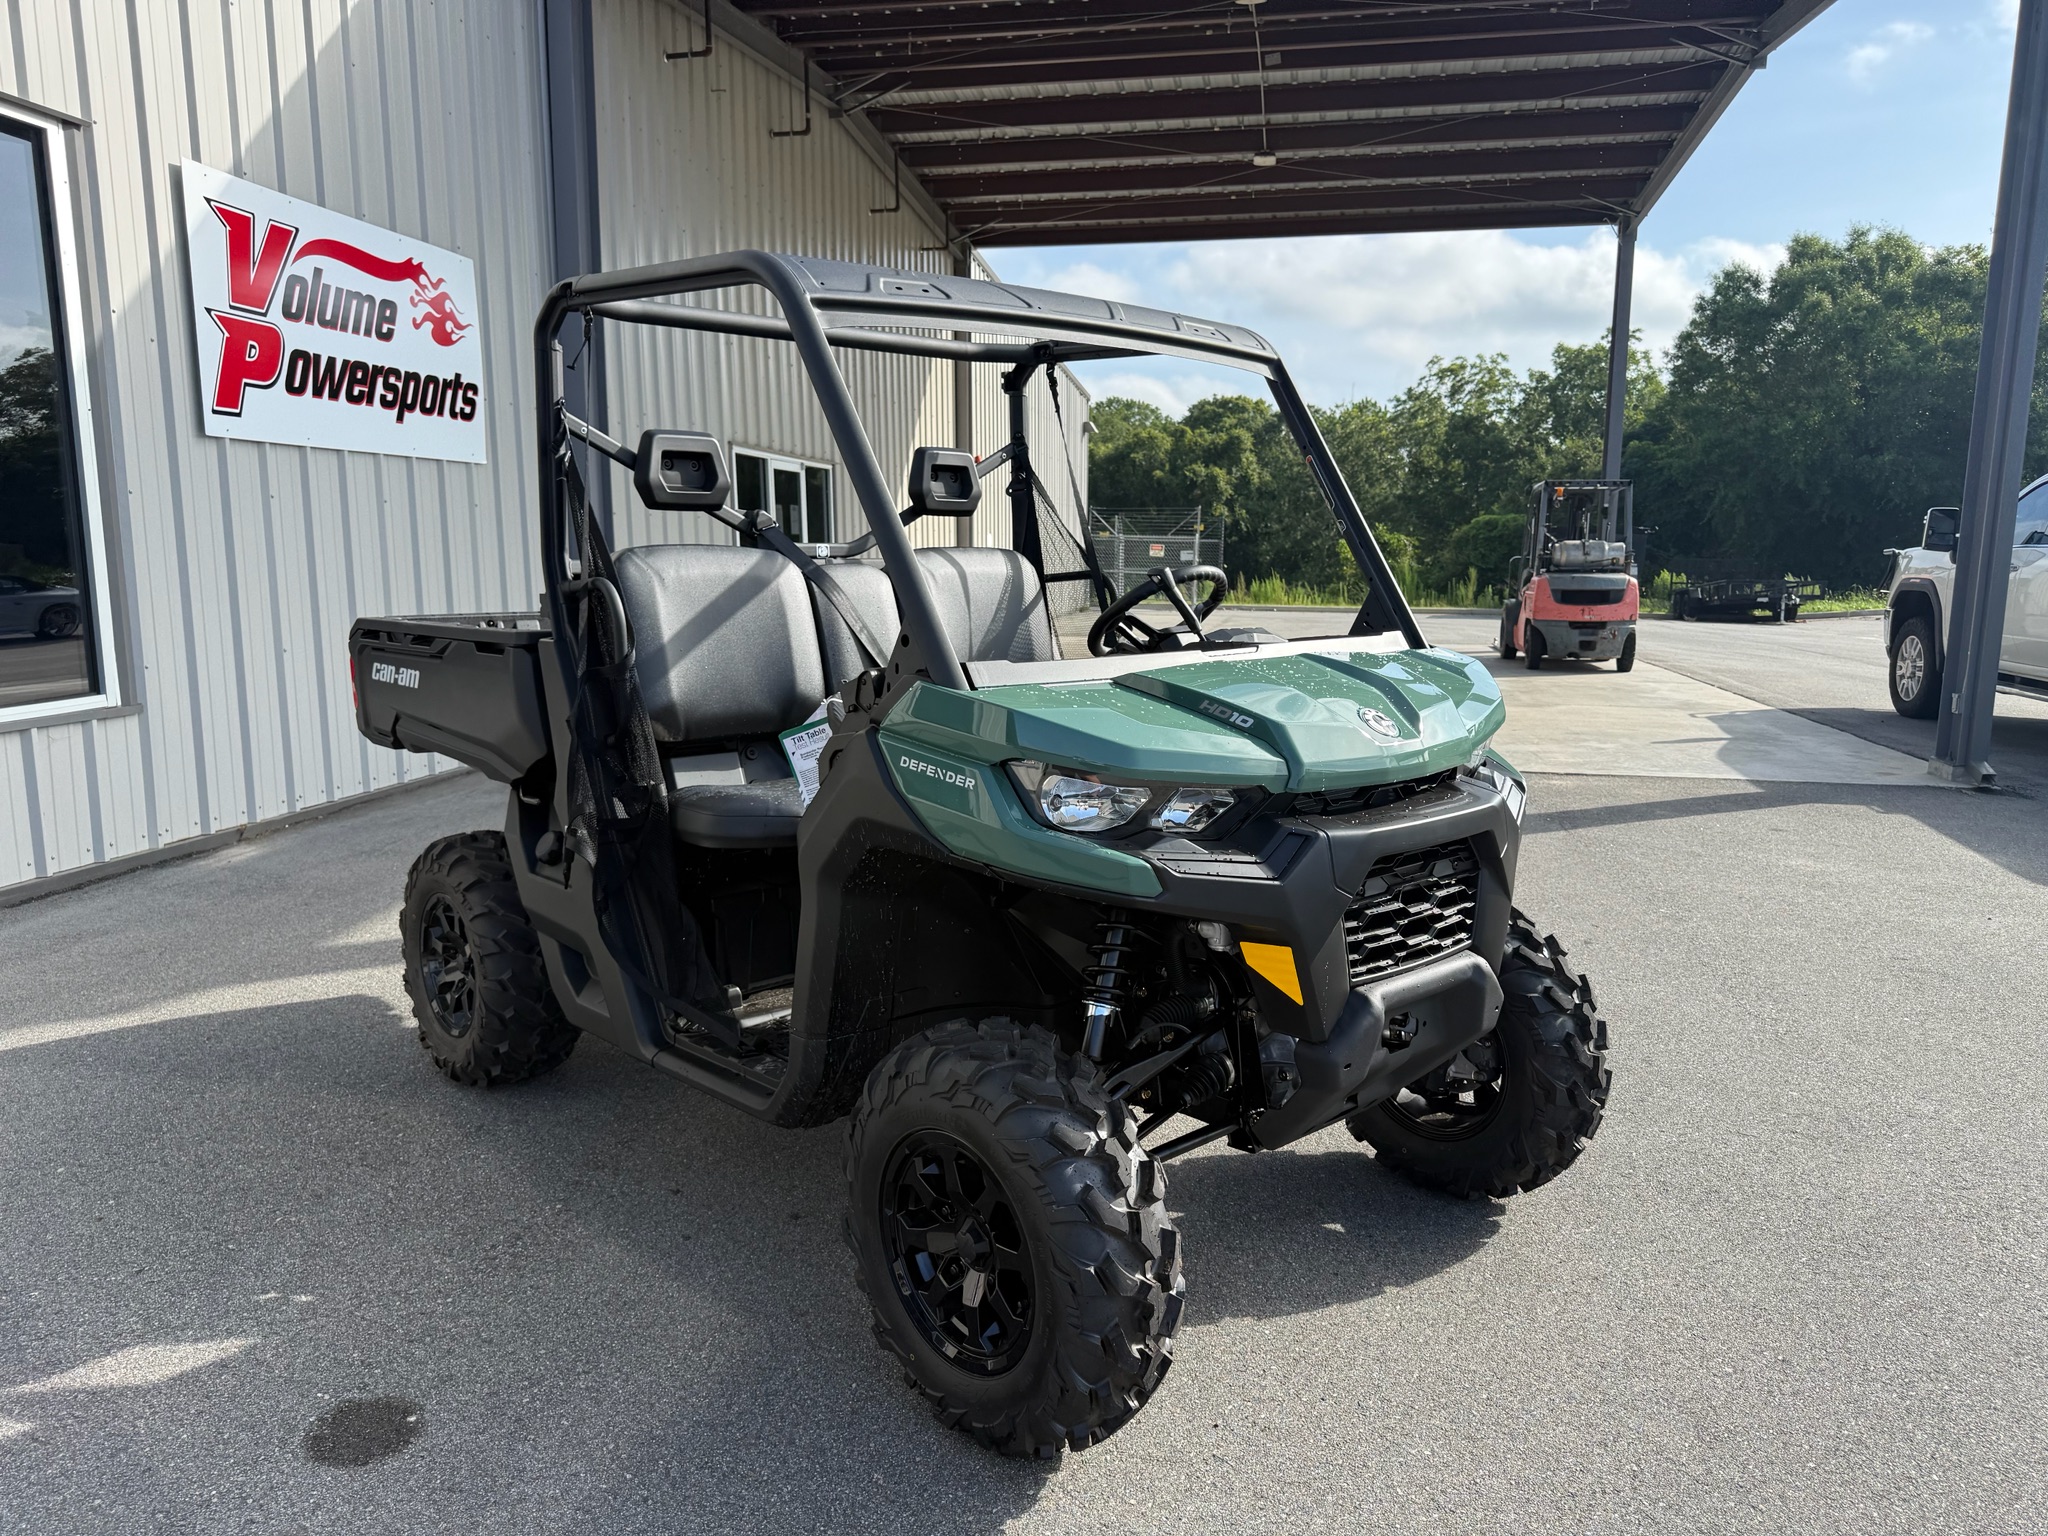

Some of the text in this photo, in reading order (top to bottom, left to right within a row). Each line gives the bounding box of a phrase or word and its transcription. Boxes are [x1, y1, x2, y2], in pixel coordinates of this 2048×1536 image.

[203, 196, 398, 343] Volume
[204, 306, 479, 424] Powersports
[371, 662, 420, 689] can-am
[1199, 699, 1254, 728] HD10
[791, 728, 826, 745] Tilt Table
[899, 755, 976, 790] DEFENDER
